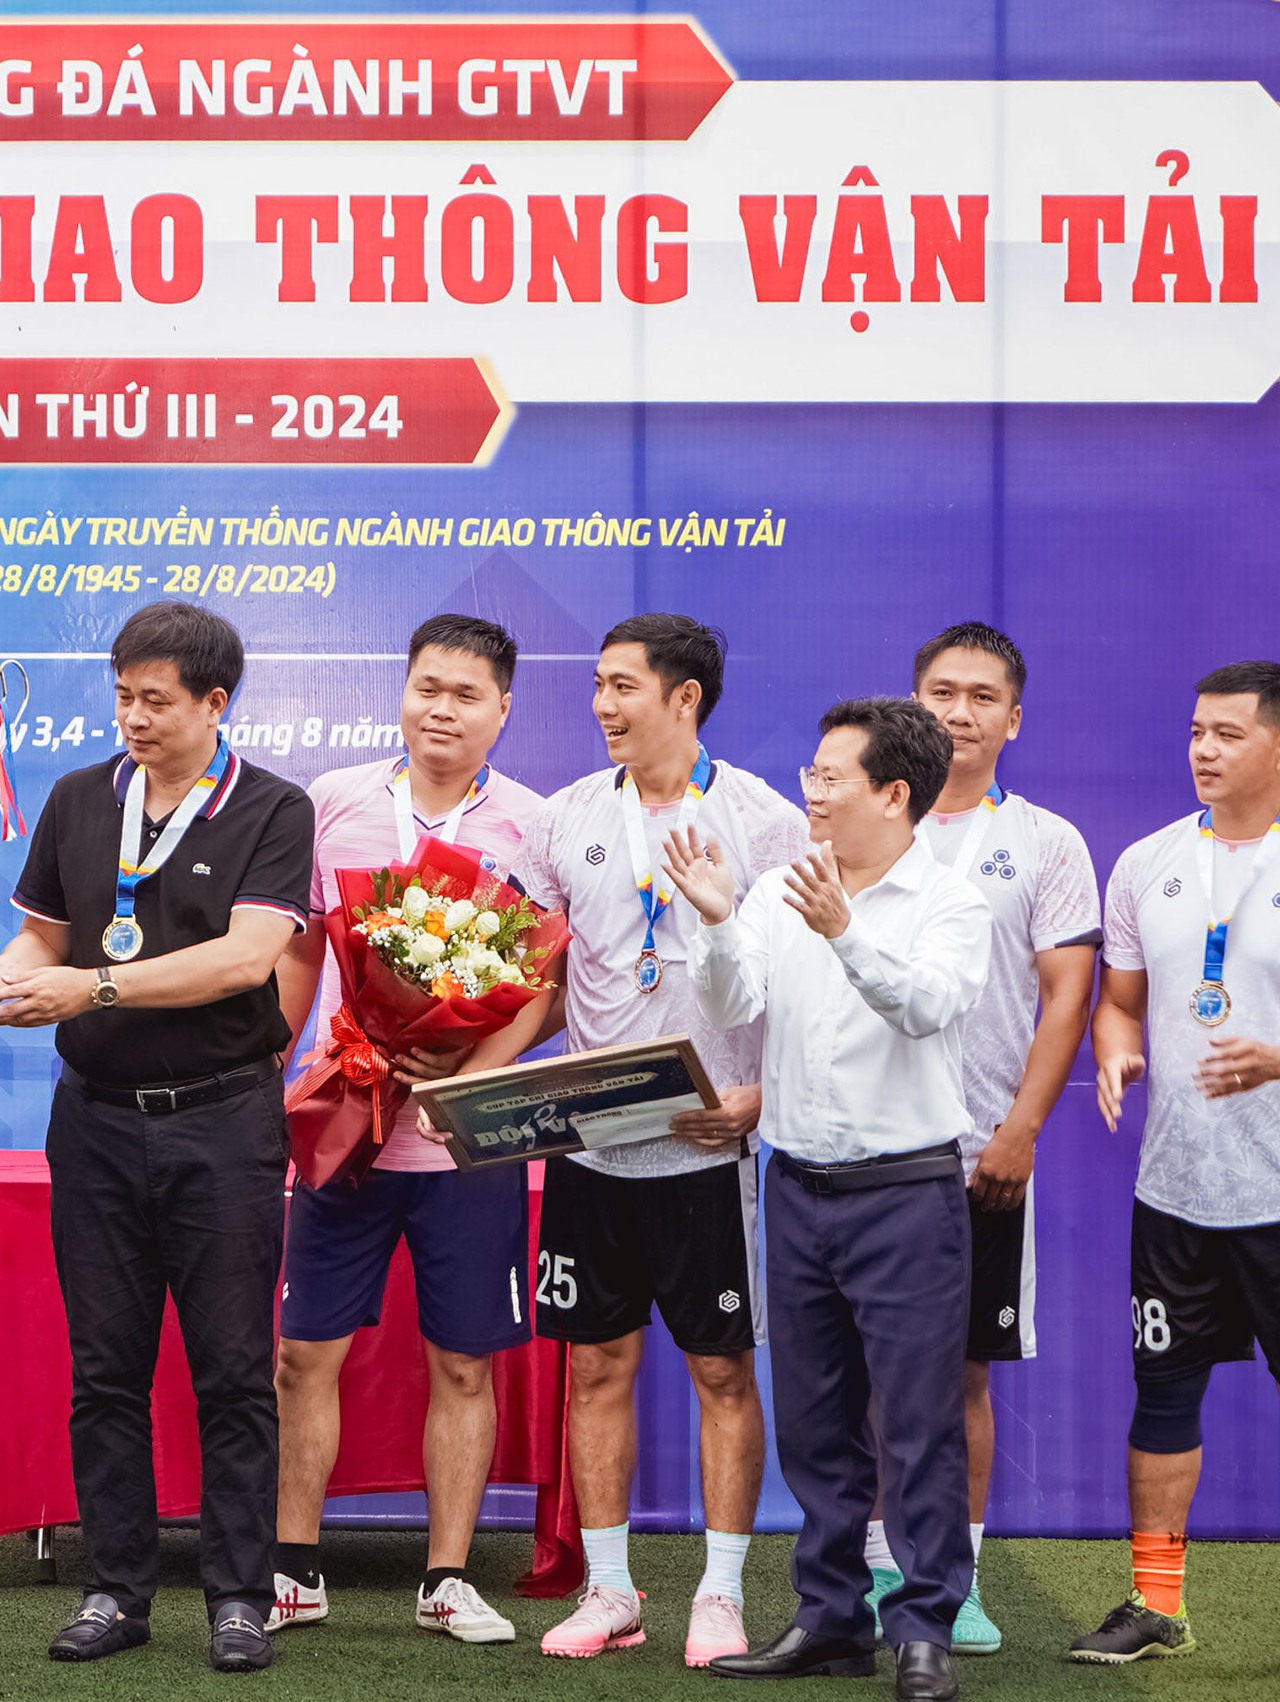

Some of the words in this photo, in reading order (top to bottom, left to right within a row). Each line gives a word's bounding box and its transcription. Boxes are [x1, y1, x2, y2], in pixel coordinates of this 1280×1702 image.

[57, 44, 157, 117] ĐÁ
[179, 43, 432, 117] NGÀNH
[458, 59, 637, 117] GTVT
[255, 163, 688, 305] THÔNG
[738, 165, 989, 334] VẬN
[1040, 149, 1259, 304] TẢI
[35, 381, 150, 439] THỨ
[166, 394, 217, 438] III
[235, 413, 254, 425] -
[270, 395, 404, 440] 2024
[85, 505, 215, 546] TRUYỀN
[219, 505, 331, 546] THỐNG
[335, 511, 455, 546] NGÀNH
[458, 518, 536, 546] GIAO
[541, 511, 652, 546] THÔNG
[658, 511, 729, 553] VẬN
[734, 508, 787, 546] TẢI
[146, 576, 158, 585] -
[163, 561, 337, 598] 28/8/2024)
[301, 717, 324, 747] 8
[535, 1249, 578, 1309] 25
[1131, 1295, 1172, 1352] 98
